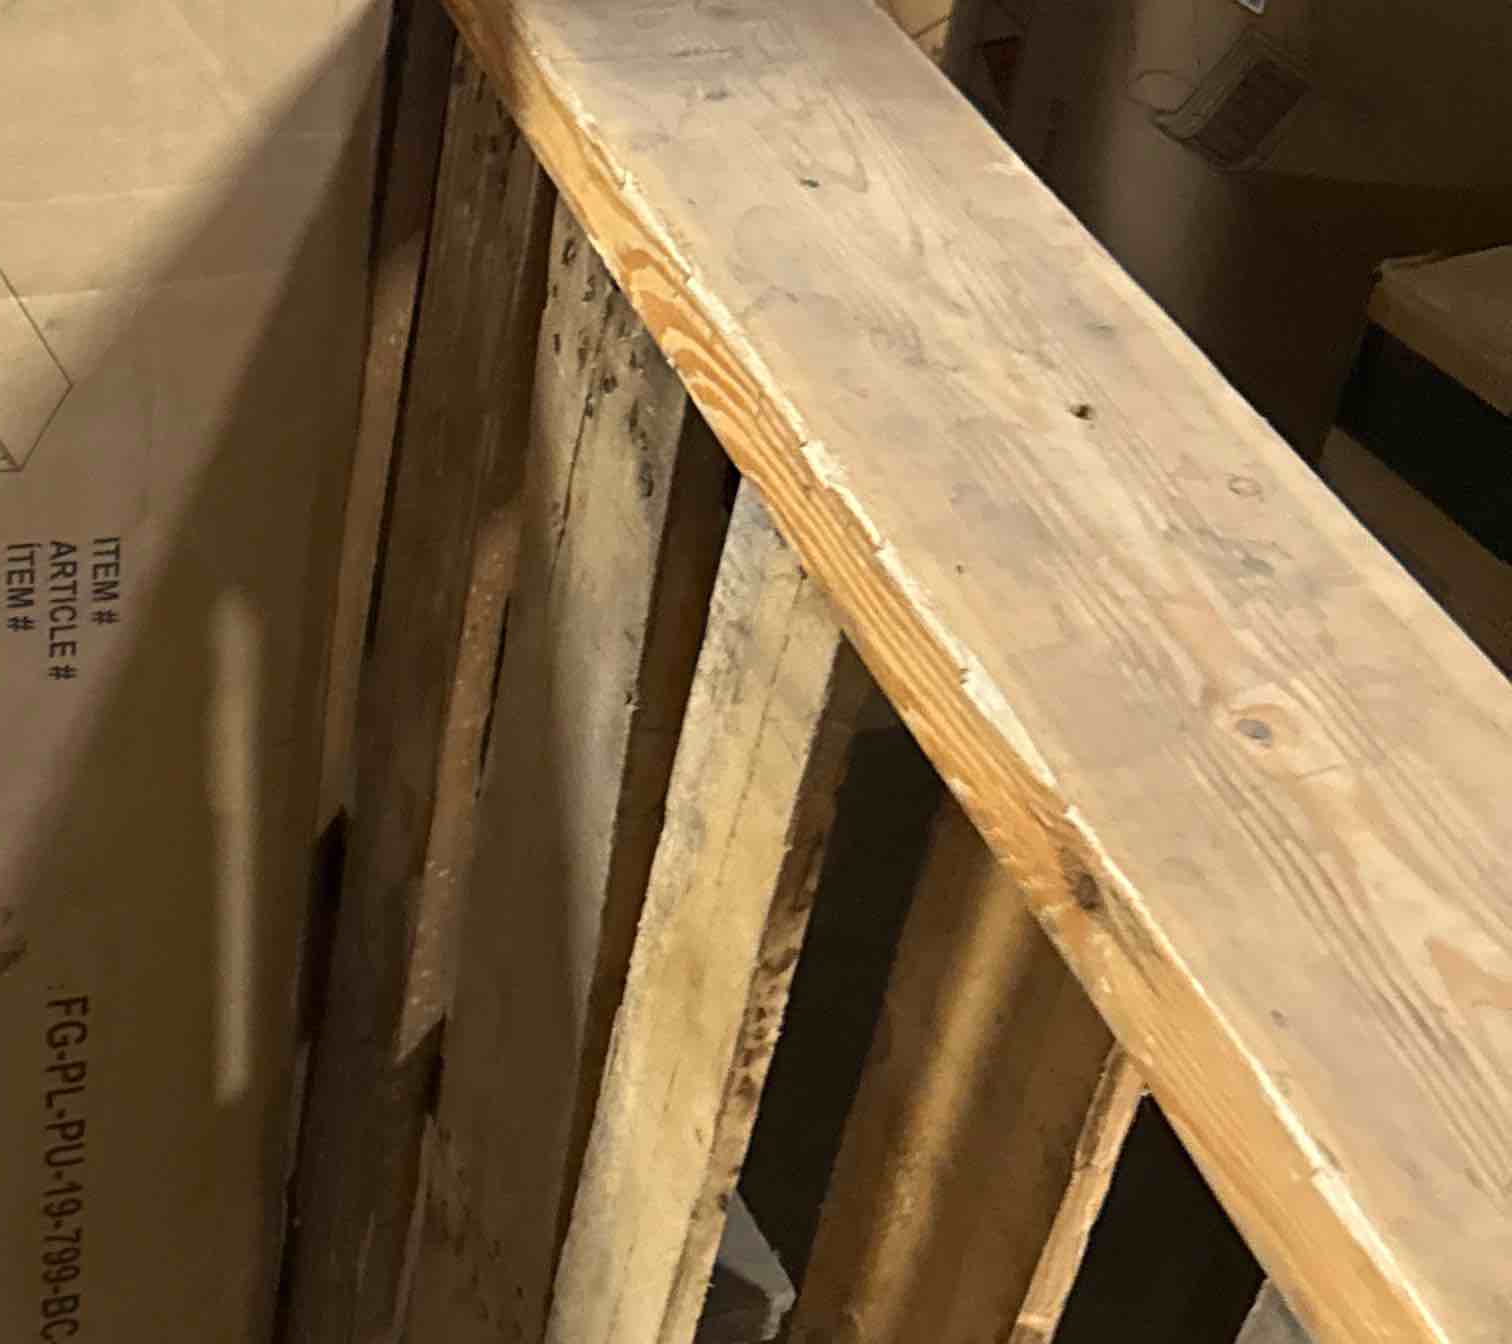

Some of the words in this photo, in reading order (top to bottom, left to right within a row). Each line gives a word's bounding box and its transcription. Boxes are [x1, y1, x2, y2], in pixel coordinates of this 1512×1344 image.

[6, 543, 43, 608] ÍTEM
[92, 536, 121, 602] ITEM
[48, 540, 78, 658] ARTICLE
[91, 610, 119, 625] #
[6, 616, 36, 632] #
[48, 664, 78, 680] #
